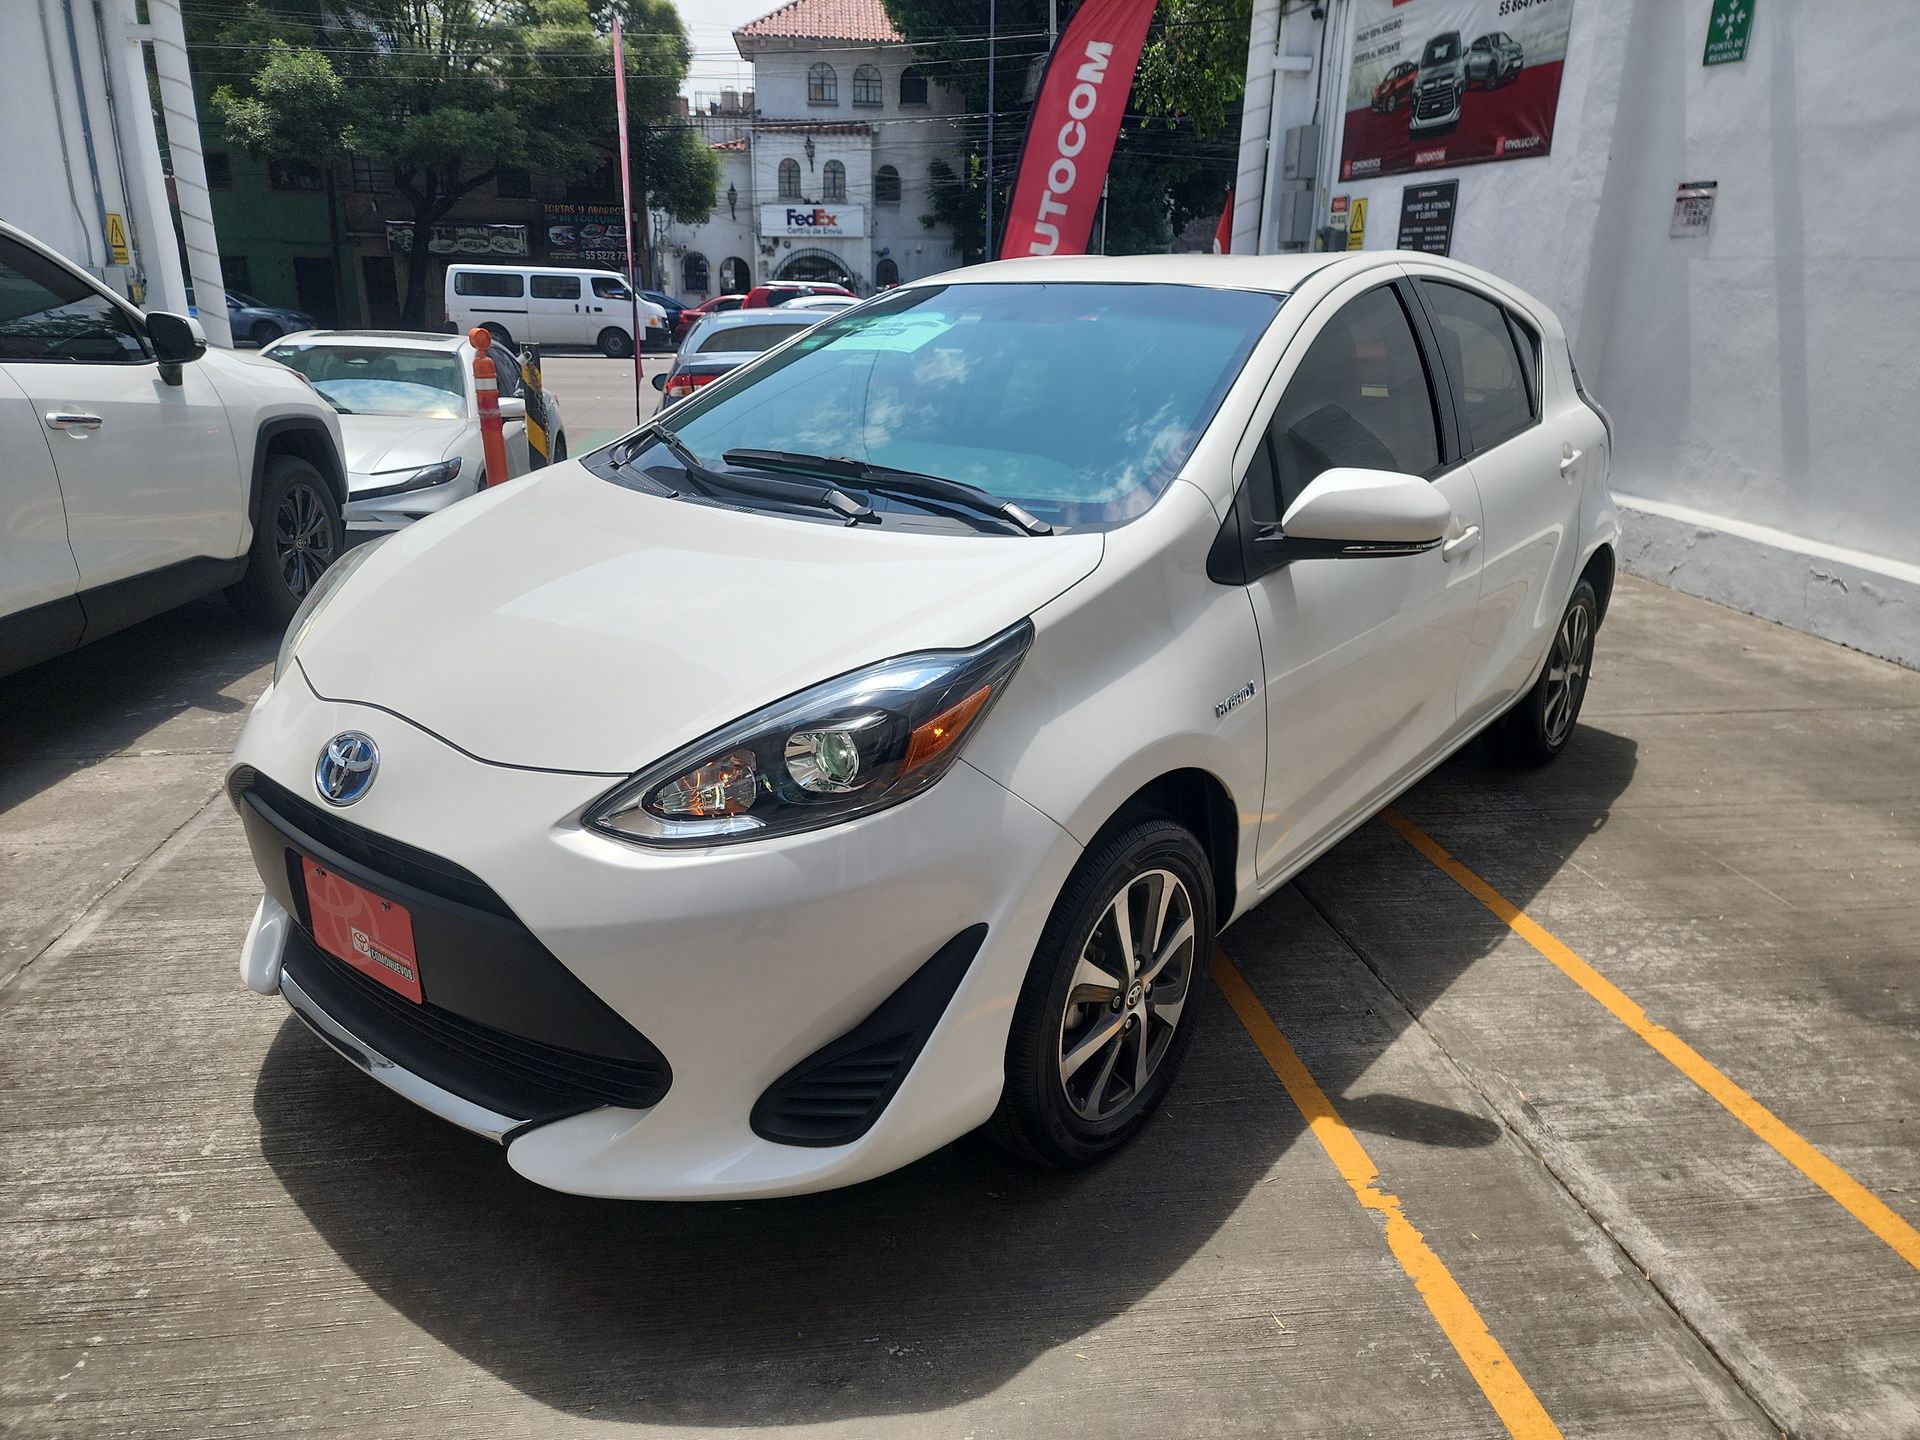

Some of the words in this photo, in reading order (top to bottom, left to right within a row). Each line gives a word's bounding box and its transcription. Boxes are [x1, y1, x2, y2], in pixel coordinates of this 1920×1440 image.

[1710, 40, 1733, 50] PUNTO
[544, 204, 575, 214] TORTAS
[786, 208, 837, 226] FedEx
[586, 250, 597, 260] 55
[598, 250, 616, 260] 5272
[1217, 684, 1253, 717] HYBRID
[371, 948, 413, 980] COMONUEVOS
